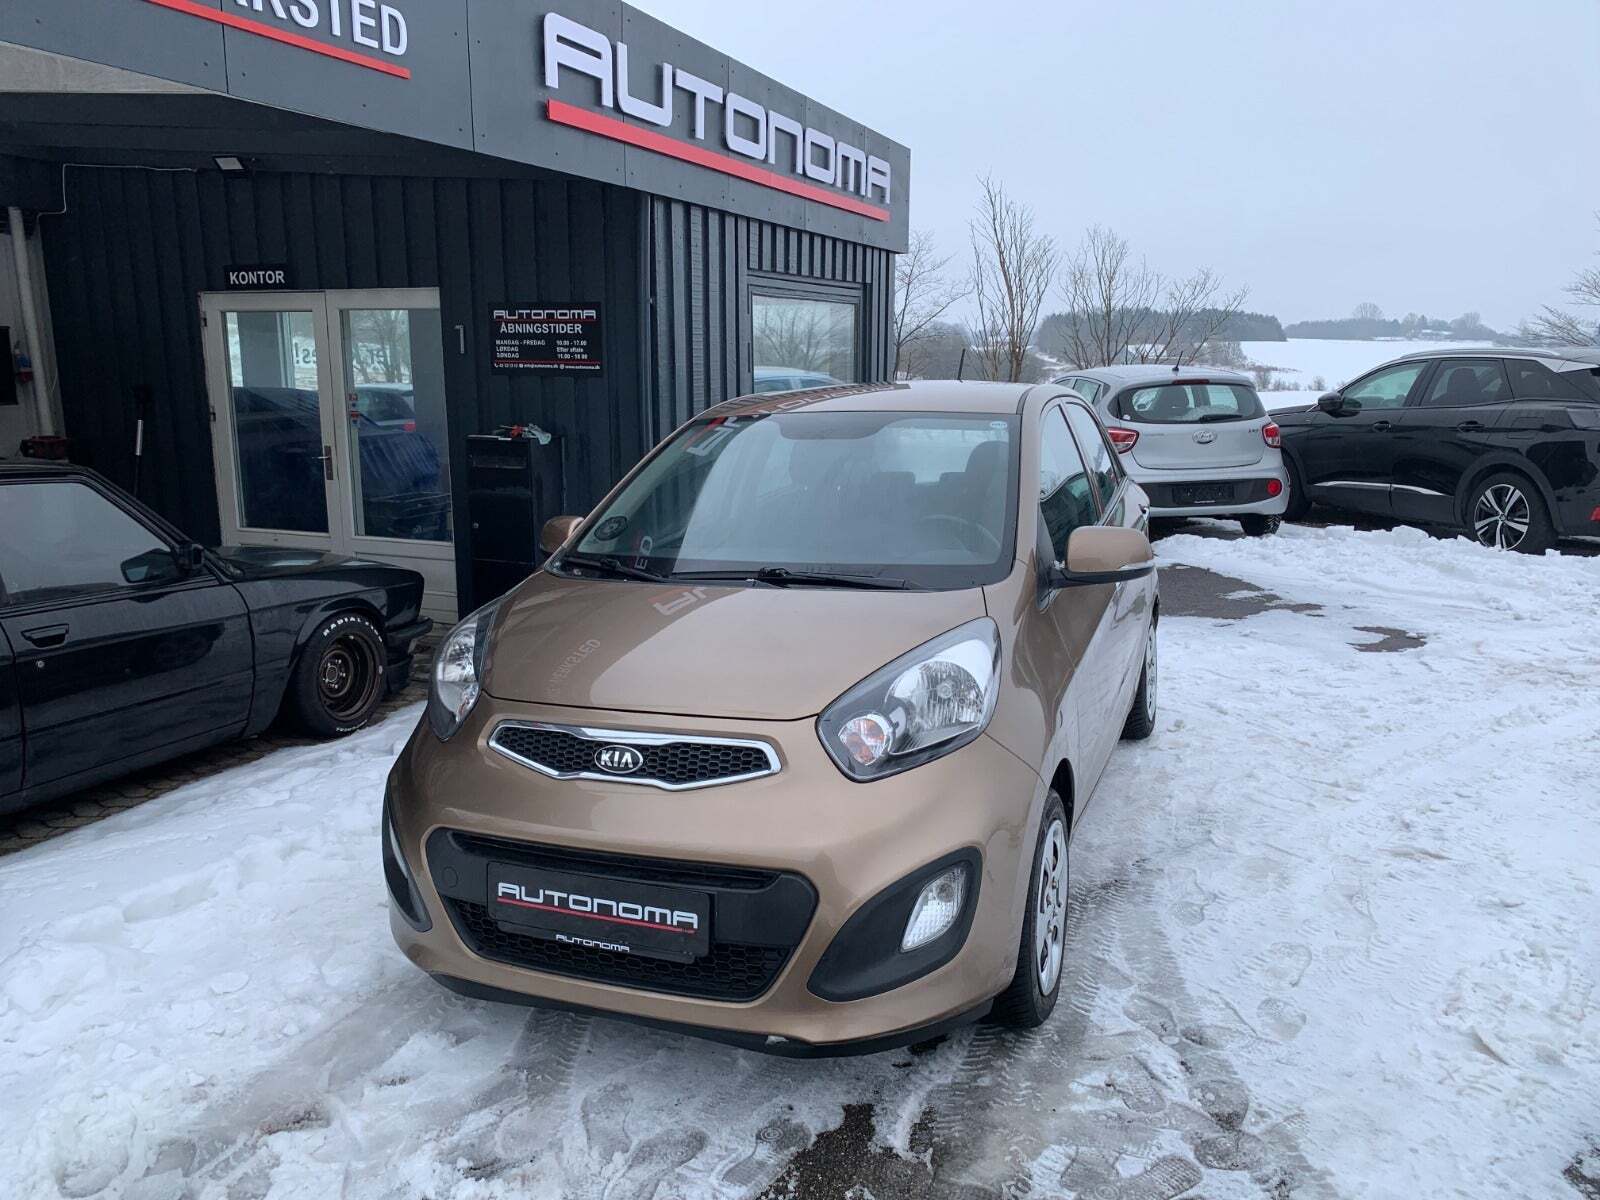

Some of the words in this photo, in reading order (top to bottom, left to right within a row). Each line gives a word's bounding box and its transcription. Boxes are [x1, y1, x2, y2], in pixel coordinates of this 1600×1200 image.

[543, 12, 892, 204] AUTONOMA
[229, 269, 285, 286] KONTOR
[493, 309, 597, 319] AUTONOMA
[500, 322, 582, 334] ÅBNINGSTIDER
[600, 749, 634, 769] KIA
[497, 882, 698, 929] AUTONOMA
[555, 933, 630, 953] AUTONOMA
